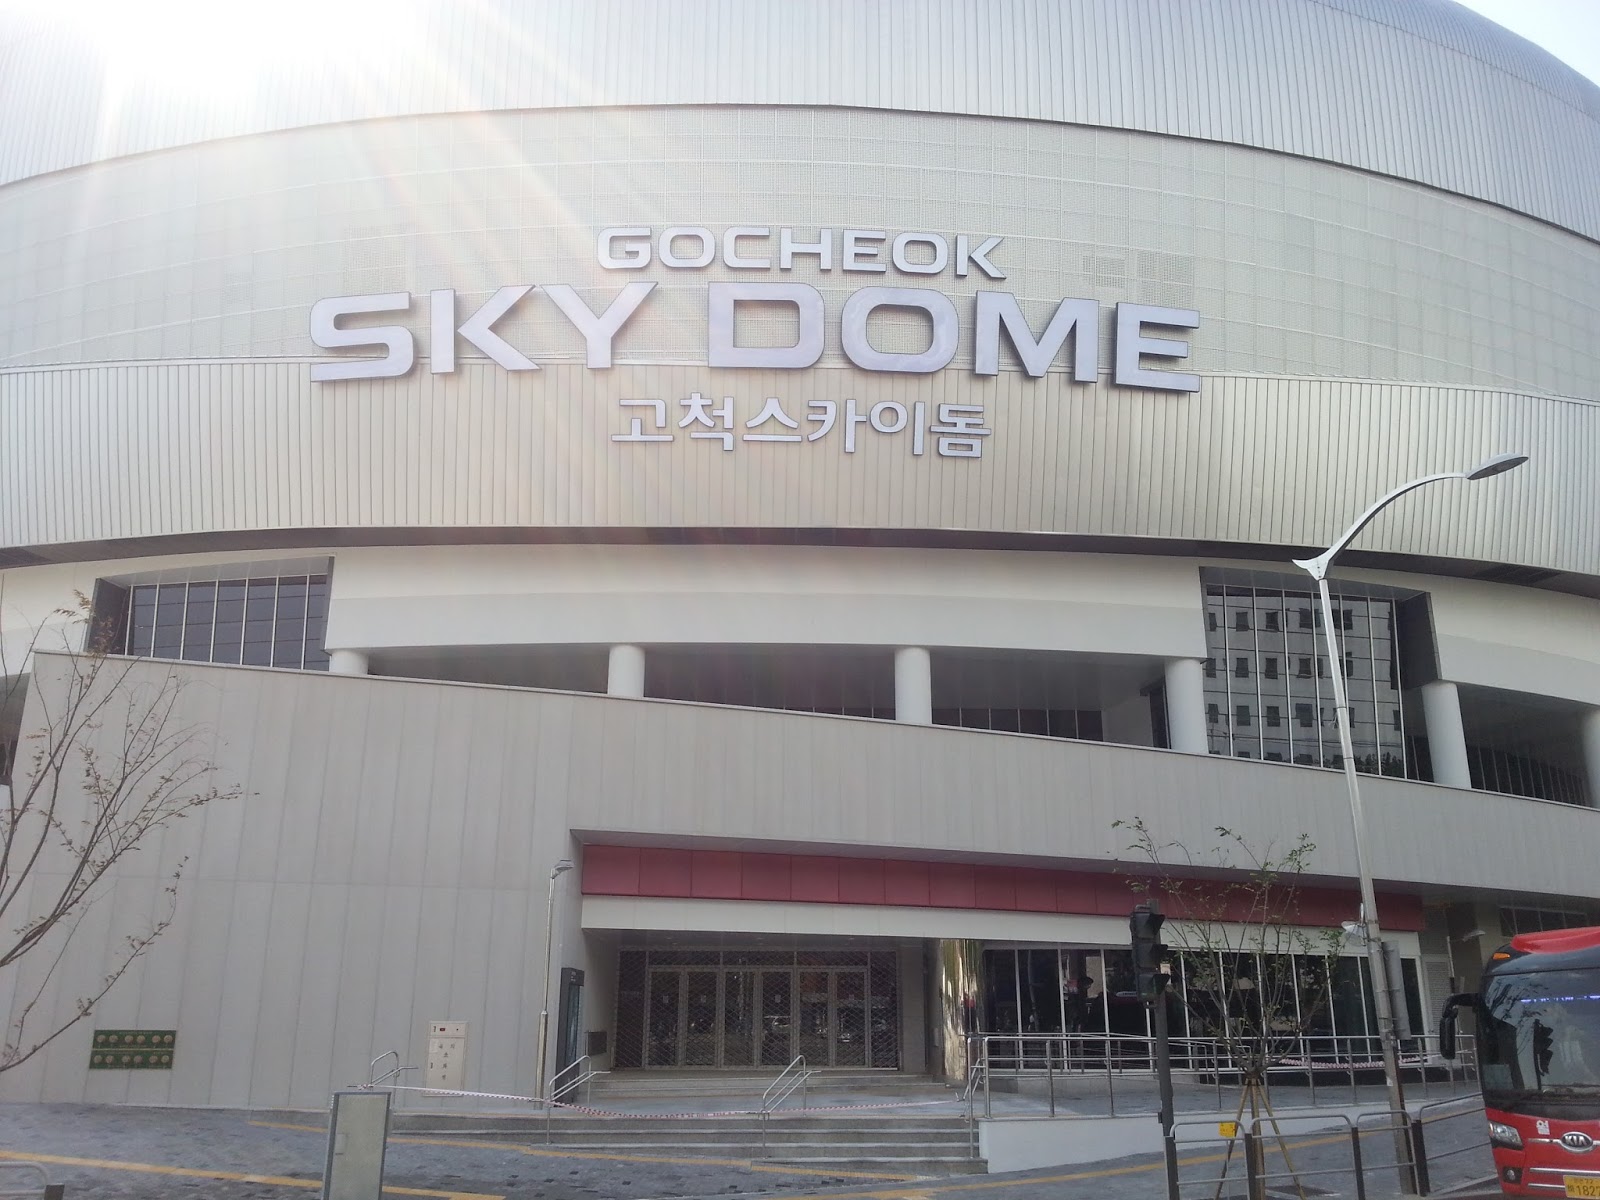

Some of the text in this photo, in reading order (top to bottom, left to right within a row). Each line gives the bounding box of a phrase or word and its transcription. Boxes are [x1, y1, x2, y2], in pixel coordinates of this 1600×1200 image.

[598, 226, 1007, 280] GOCHEOK
[310, 281, 1200, 393] SKY DOME
[611, 392, 992, 459] 고척스카이돔
[1564, 1135, 1588, 1146] KIA
